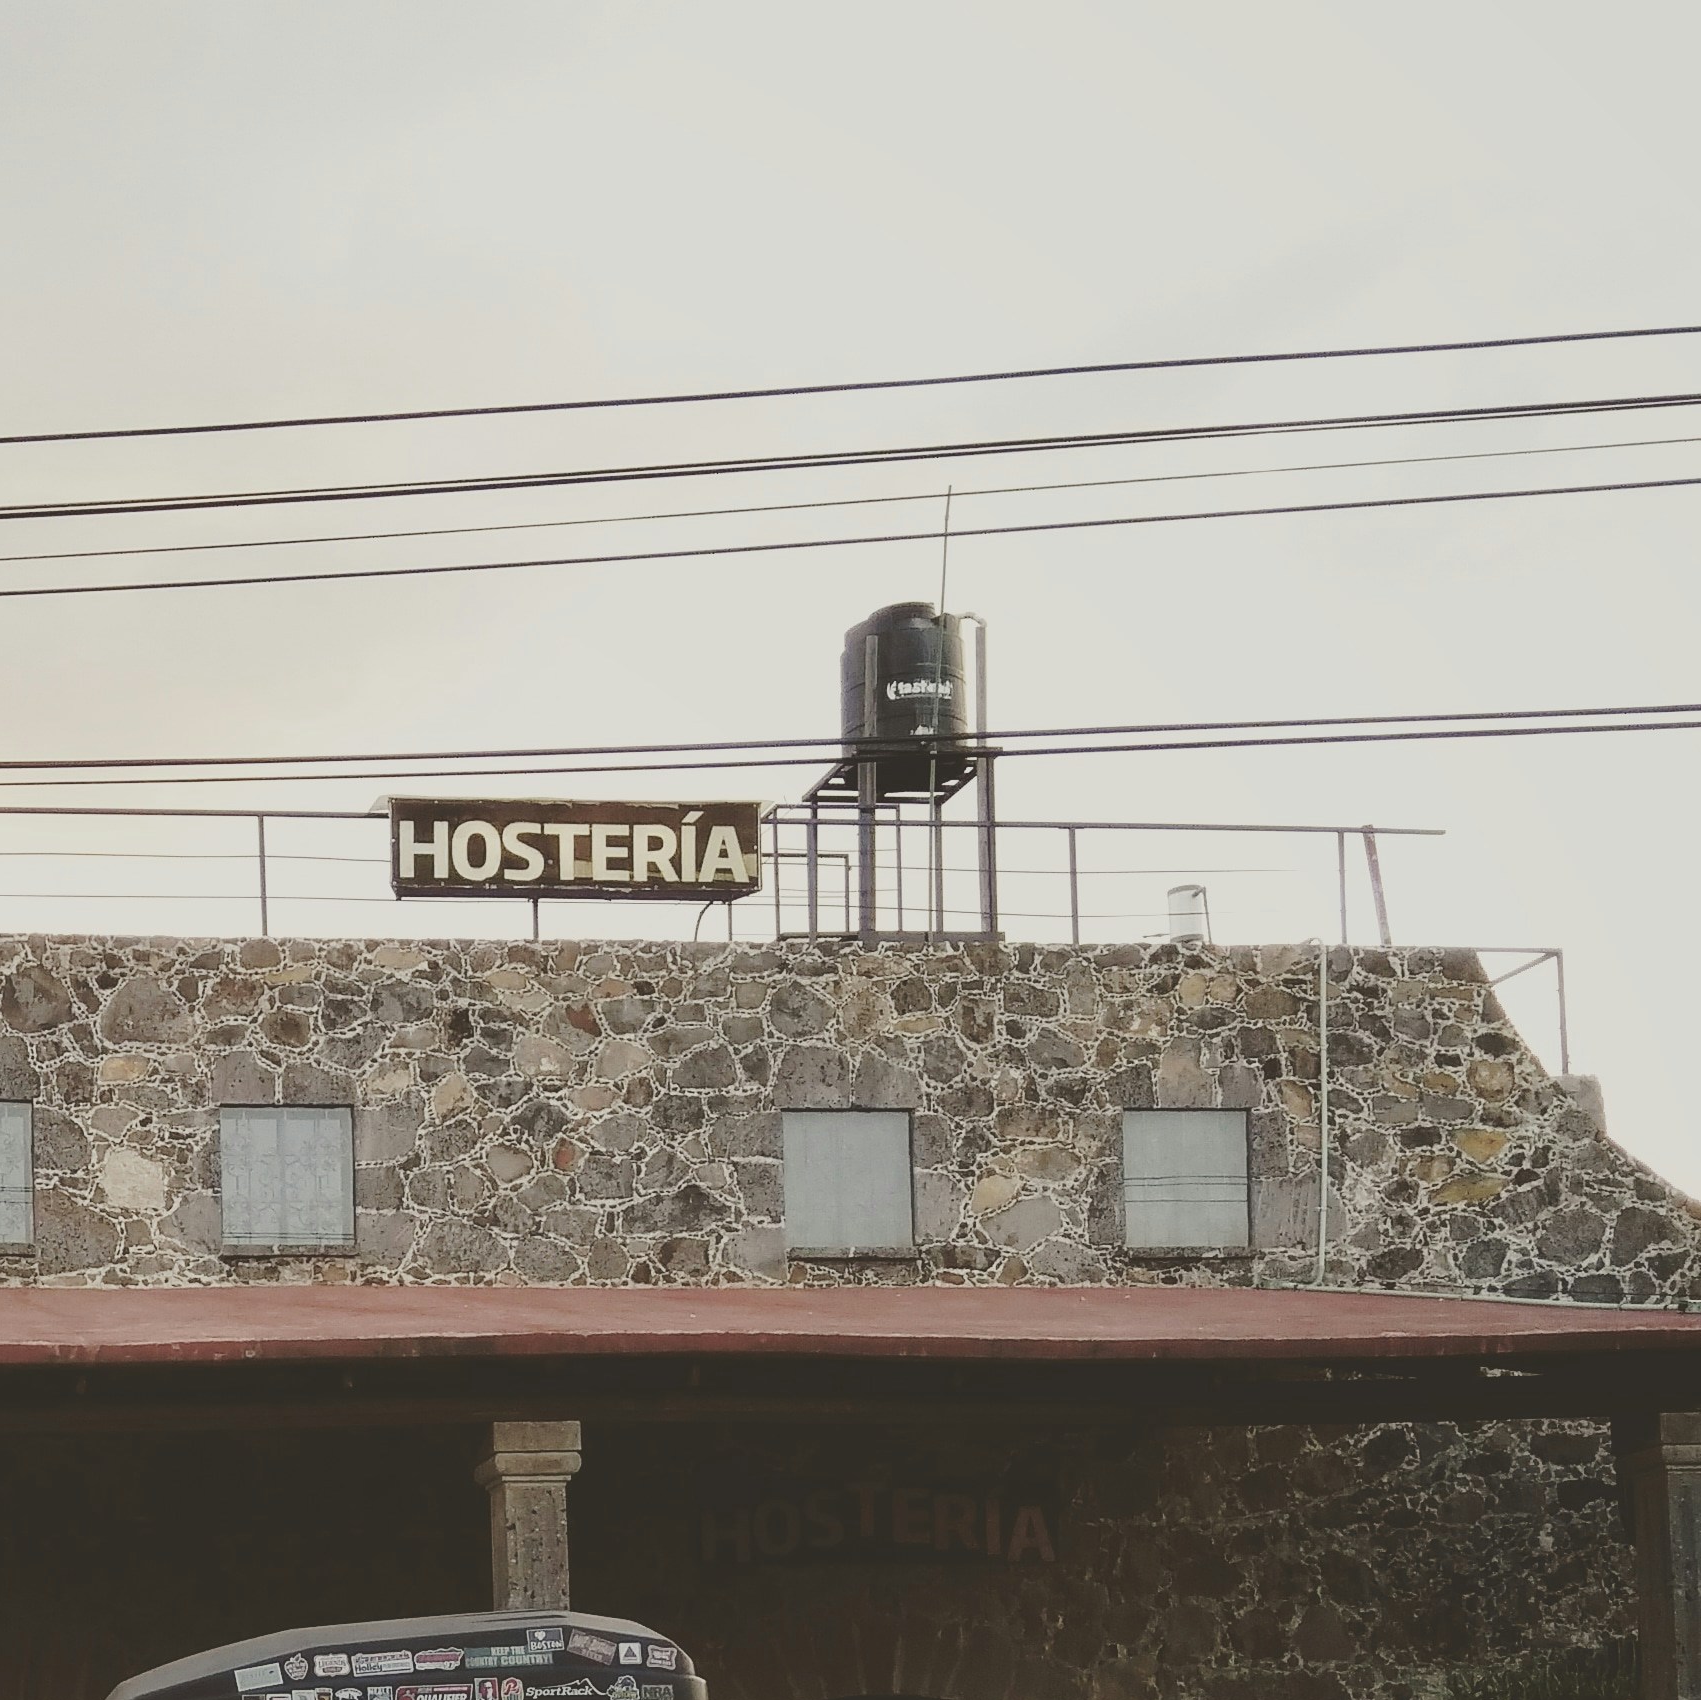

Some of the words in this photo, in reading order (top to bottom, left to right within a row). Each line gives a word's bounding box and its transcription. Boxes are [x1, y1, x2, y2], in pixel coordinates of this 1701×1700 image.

[398, 810, 750, 883] HOSTERÍA
[510, 1646, 525, 1655] THE
[531, 1641, 563, 1651] BOSTON
[500, 1653, 553, 1665] COUNTRY!
[526, 1686, 593, 1699] SportRack
[643, 1686, 673, 1698] NRA
